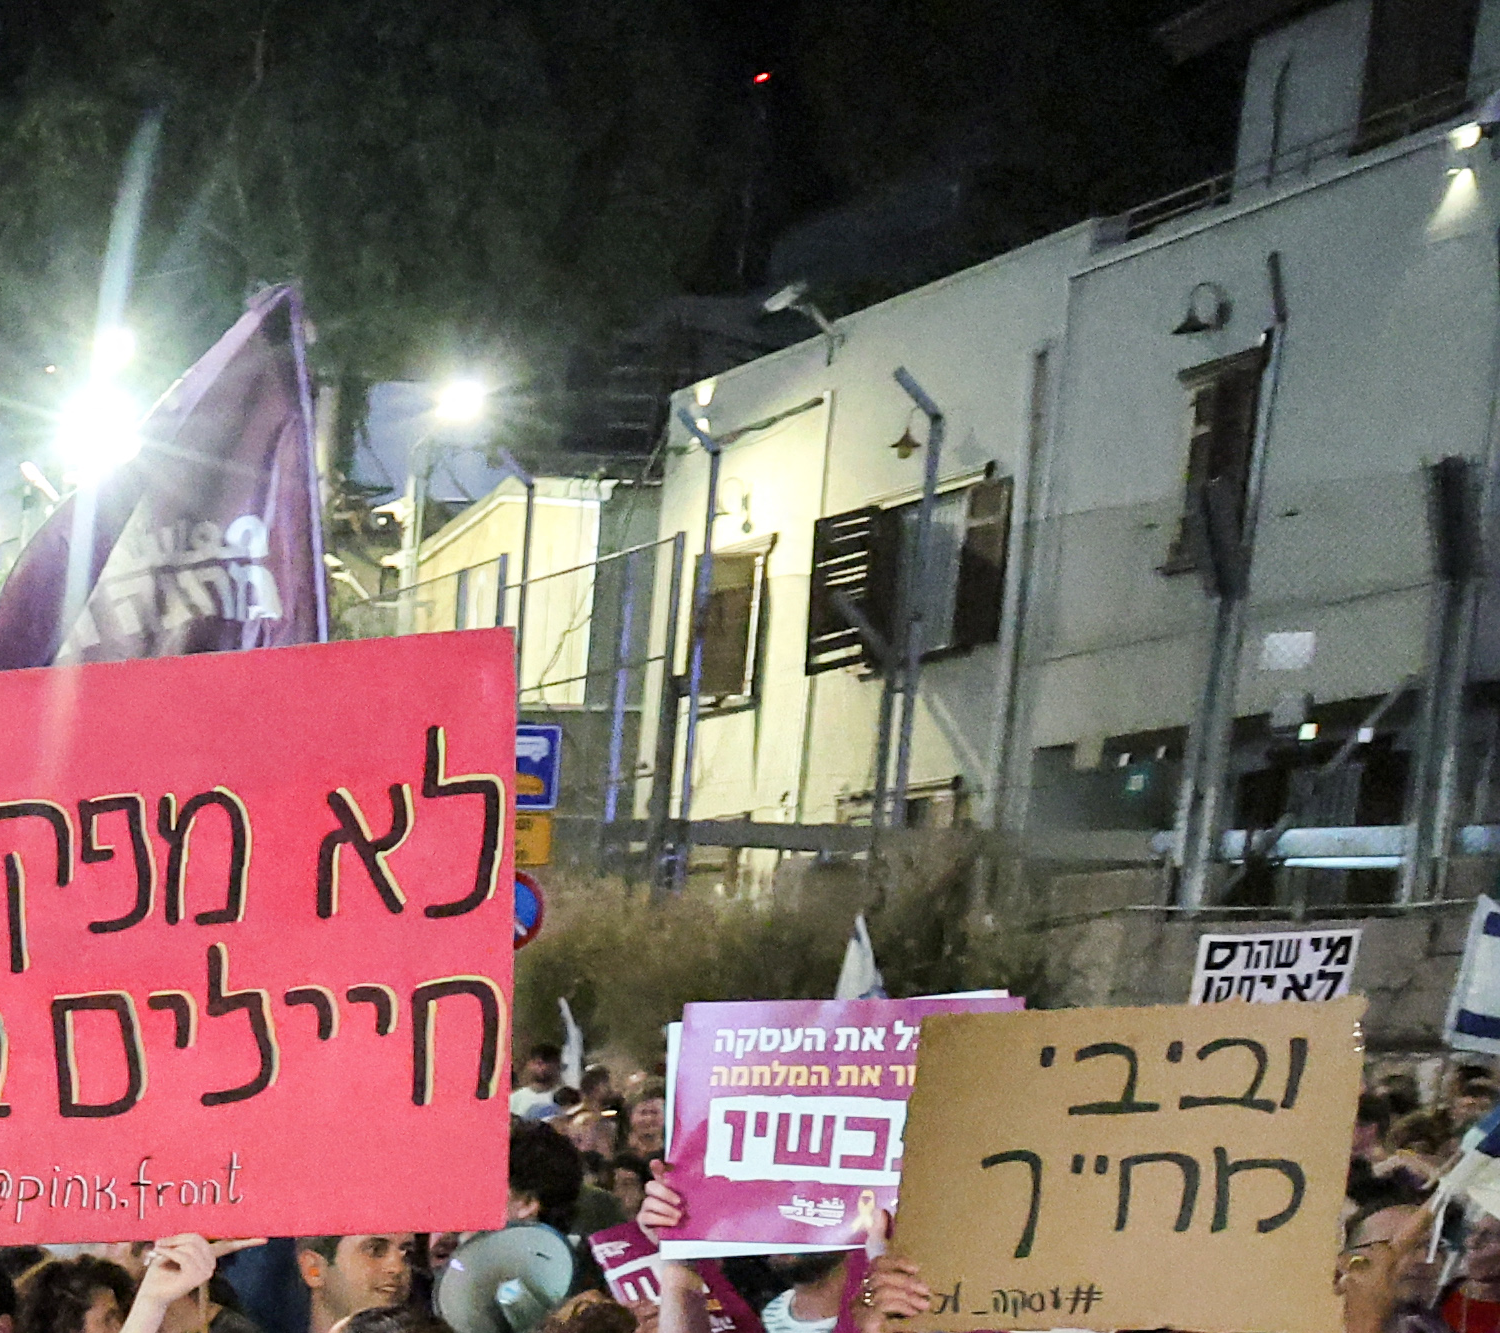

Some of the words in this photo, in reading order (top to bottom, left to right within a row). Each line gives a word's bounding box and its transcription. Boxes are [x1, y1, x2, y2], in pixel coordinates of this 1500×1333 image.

[316, 725, 506, 920] לא
[1203, 940, 1300, 971] שהרס
[1310, 936, 1354, 966] מי
[1281, 971, 1343, 1000] לא
[50, 943, 508, 1120] חיילים
[715, 1026, 827, 1059] העסקה
[834, 1026, 885, 1052] את
[709, 1060, 829, 1087] המלחמה
[837, 1064, 881, 1087] את
[1039, 1037, 1308, 1115] וביבי
[724, 1110, 901, 1172] כשיו
